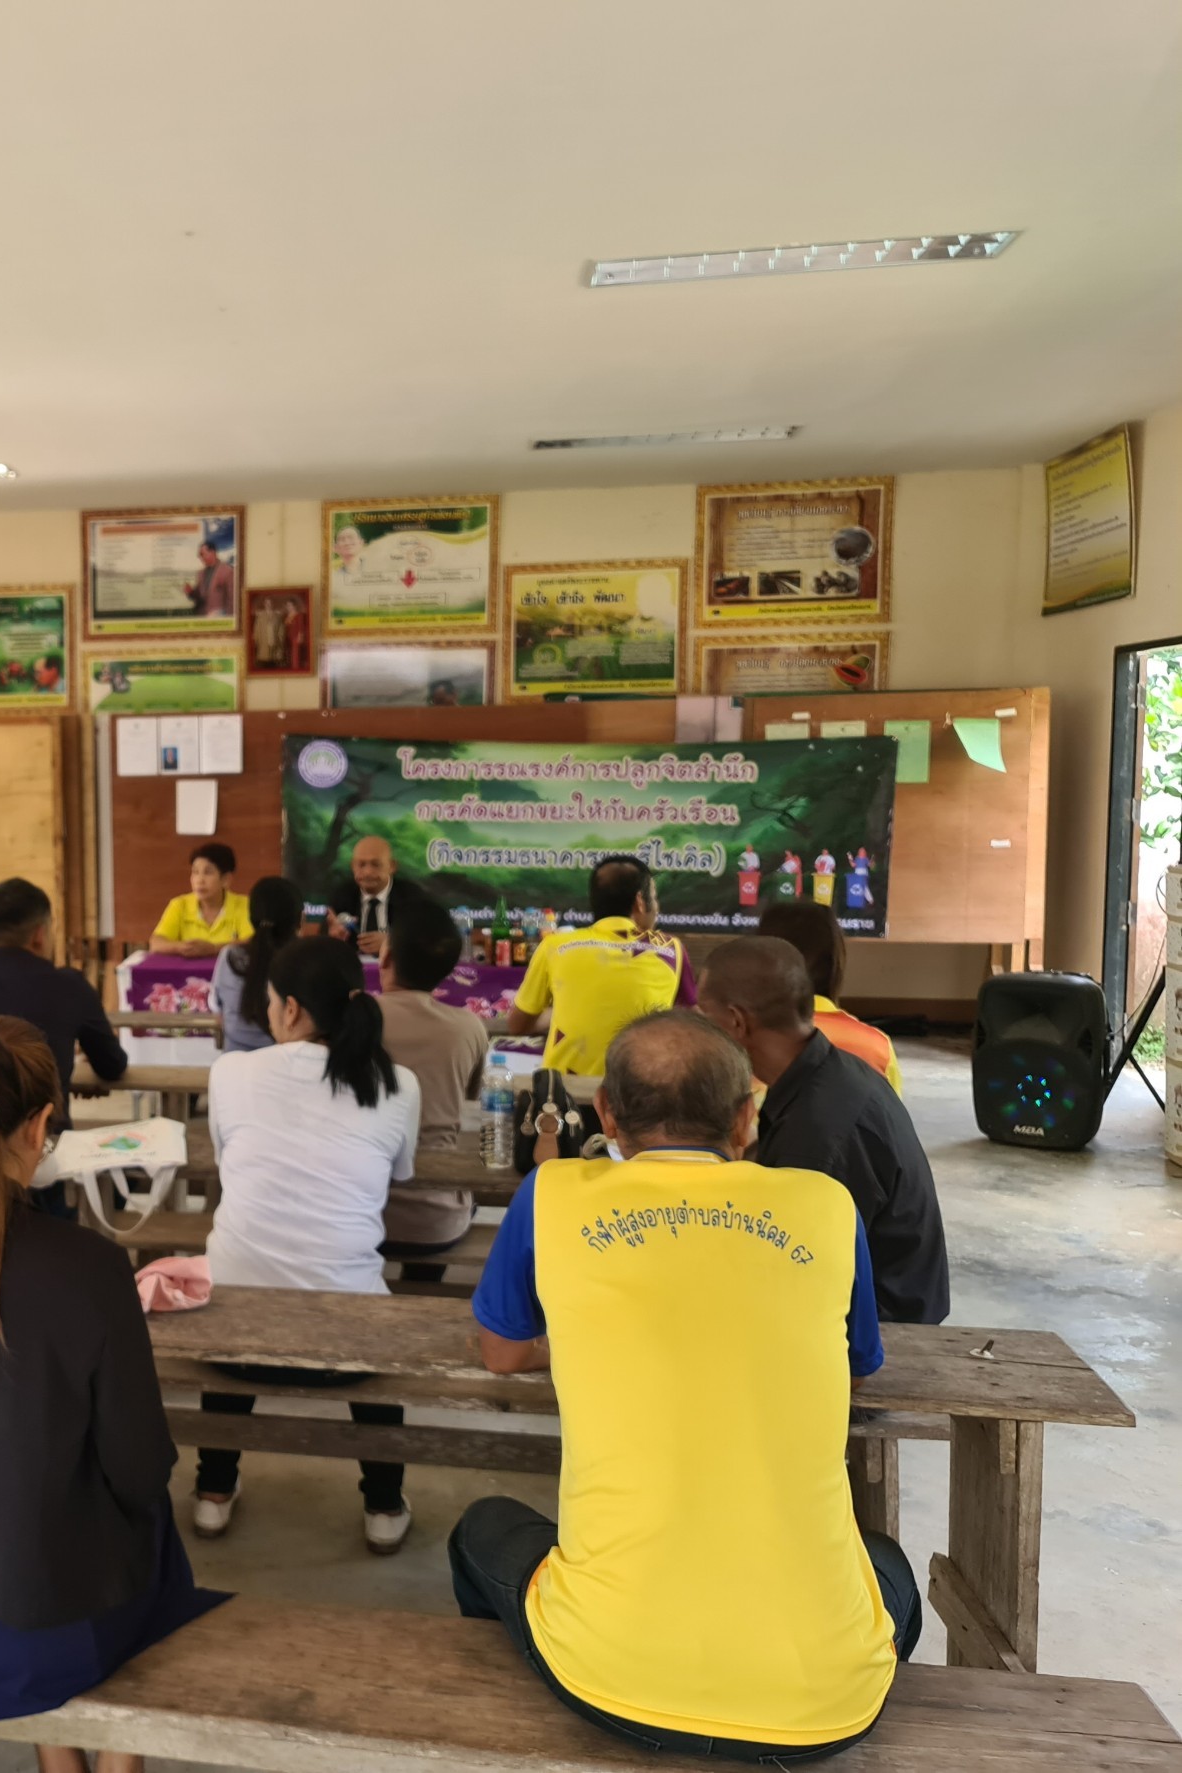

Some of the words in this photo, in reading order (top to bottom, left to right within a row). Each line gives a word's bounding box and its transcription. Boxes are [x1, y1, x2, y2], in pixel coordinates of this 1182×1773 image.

[398, 747, 758, 788] โครงการรณรงค์การปลูกจิตสำนึก
[415, 791, 740, 825] การคัดแยกขยะให้กับครัวเรือน
[428, 839, 724, 875] (กิจกรรมธนาคารรีไซเคิล)
[581, 1199, 791, 1252] กีฬาผู้สูงอายุตำบลบ้านนิคม
[790, 1244, 814, 1265] 67
